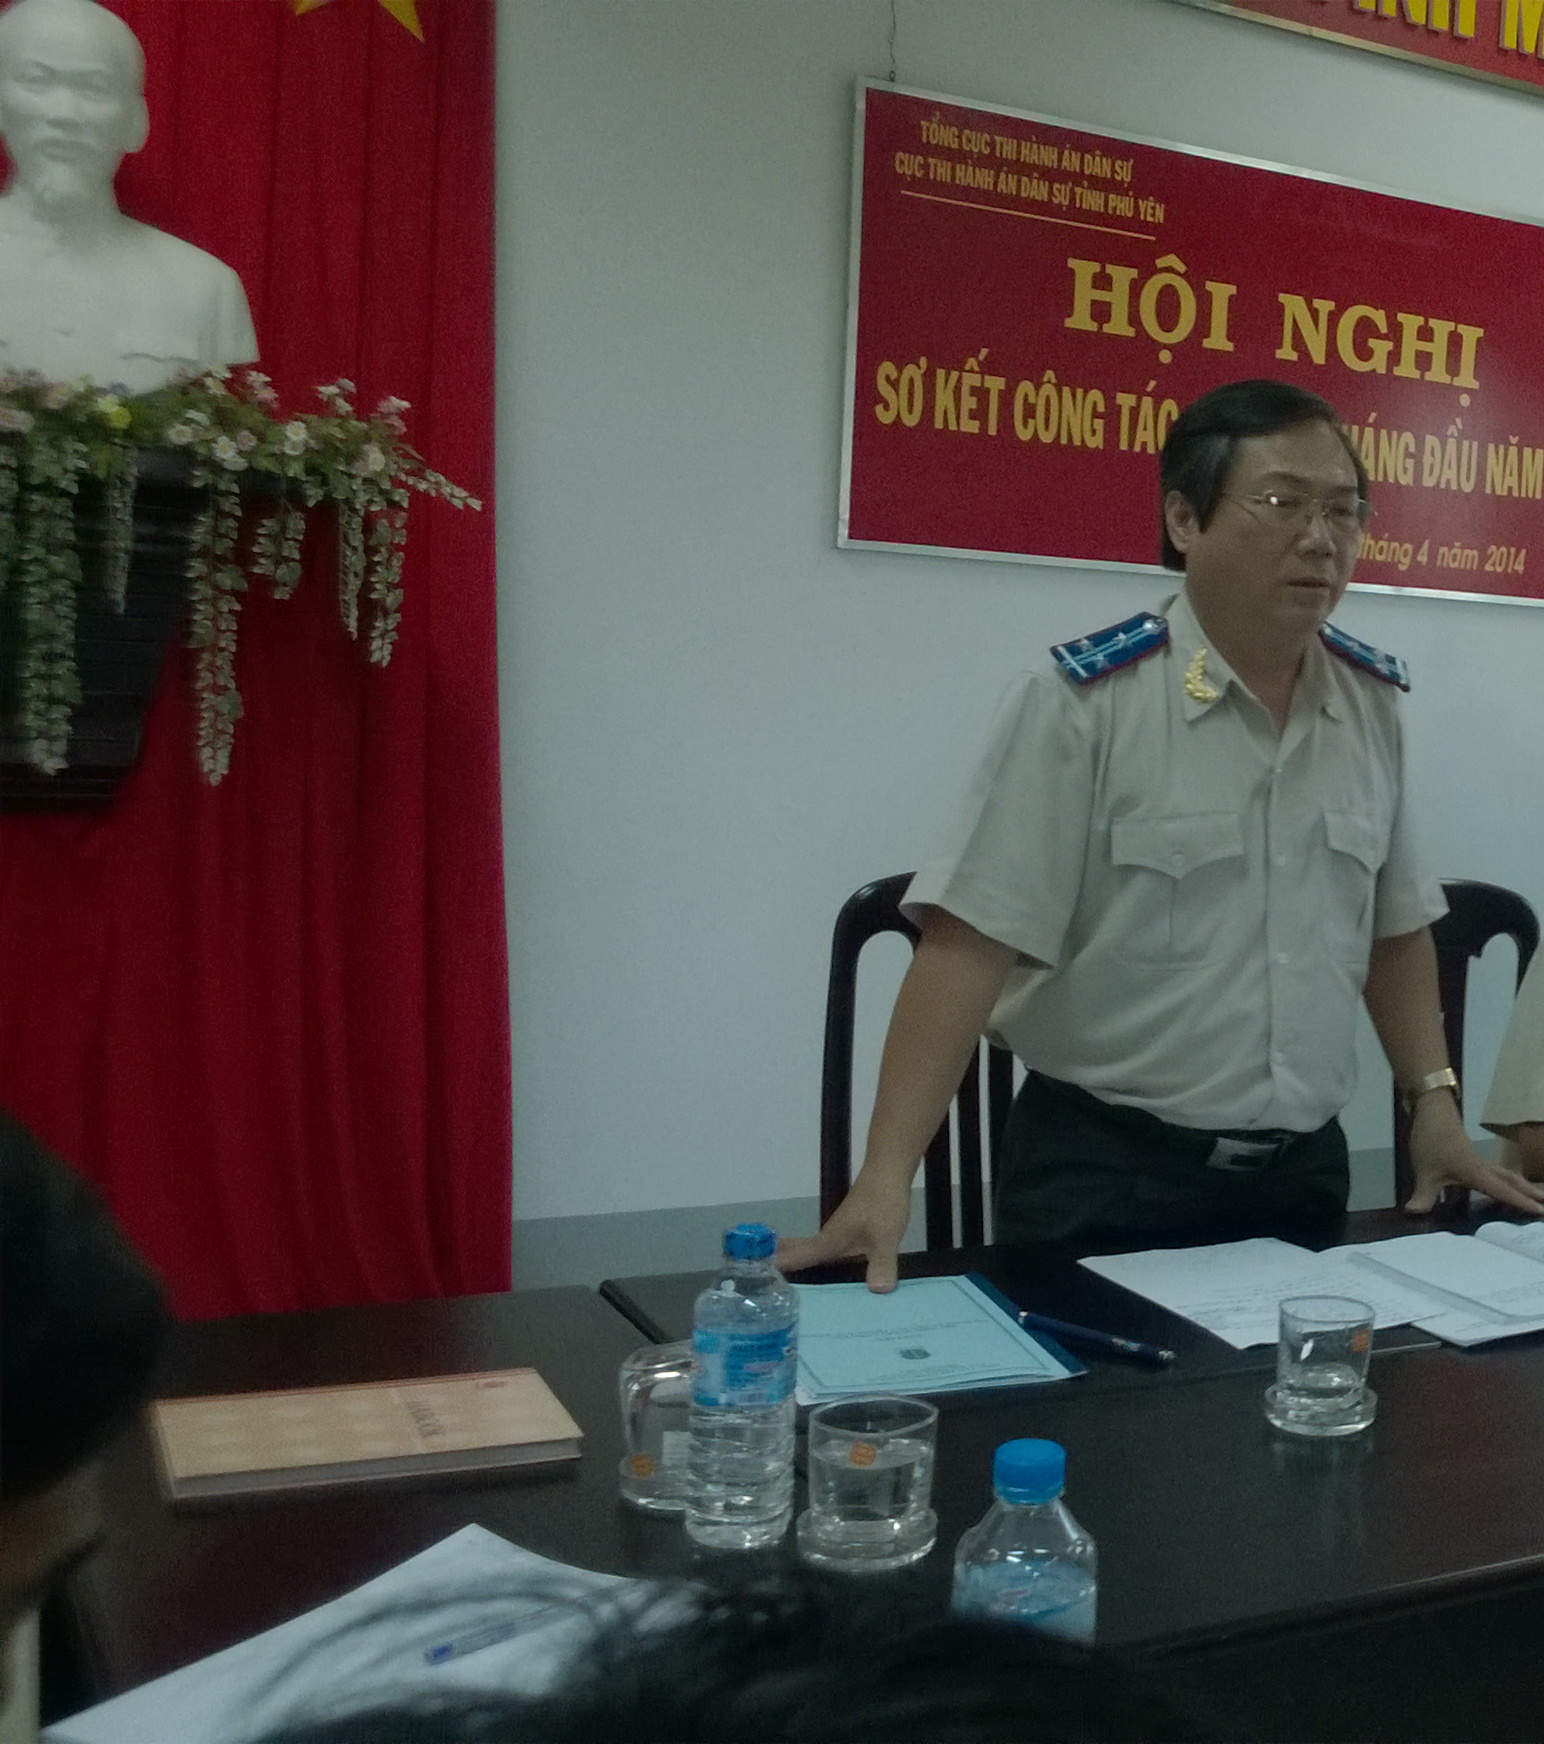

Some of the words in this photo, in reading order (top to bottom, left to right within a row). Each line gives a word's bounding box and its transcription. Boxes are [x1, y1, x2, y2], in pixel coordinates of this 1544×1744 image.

[895, 151, 925, 181] CỤC
[928, 157, 952, 183] THI
[955, 159, 995, 191] HÀNH
[997, 166, 1018, 196] ÁN
[1020, 172, 1049, 202] DÂN
[1052, 182, 1073, 212] SỰ
[1138, 196, 1165, 224] YÊN
[921, 111, 959, 149] TỔNG
[961, 129, 991, 158] CỤC
[994, 135, 1018, 160] THI
[1020, 135, 1058, 169] HÀNH
[1061, 144, 1081, 173] ÁN
[1084, 150, 1112, 178] DÂN
[1114, 158, 1134, 188] SỰ
[1064, 253, 1237, 364] HỘI
[1275, 292, 1485, 407] NGHỊ
[874, 356, 927, 427] SƠ
[934, 348, 1005, 436] KẾT
[1013, 370, 1105, 449] CÔNG
[1422, 417, 1478, 493] ĐẦU
[1485, 435, 1544, 500] NĂM
[1416, 539, 1430, 566] 4
[1437, 541, 1479, 571] năm
[1484, 545, 1527, 575] 2014
